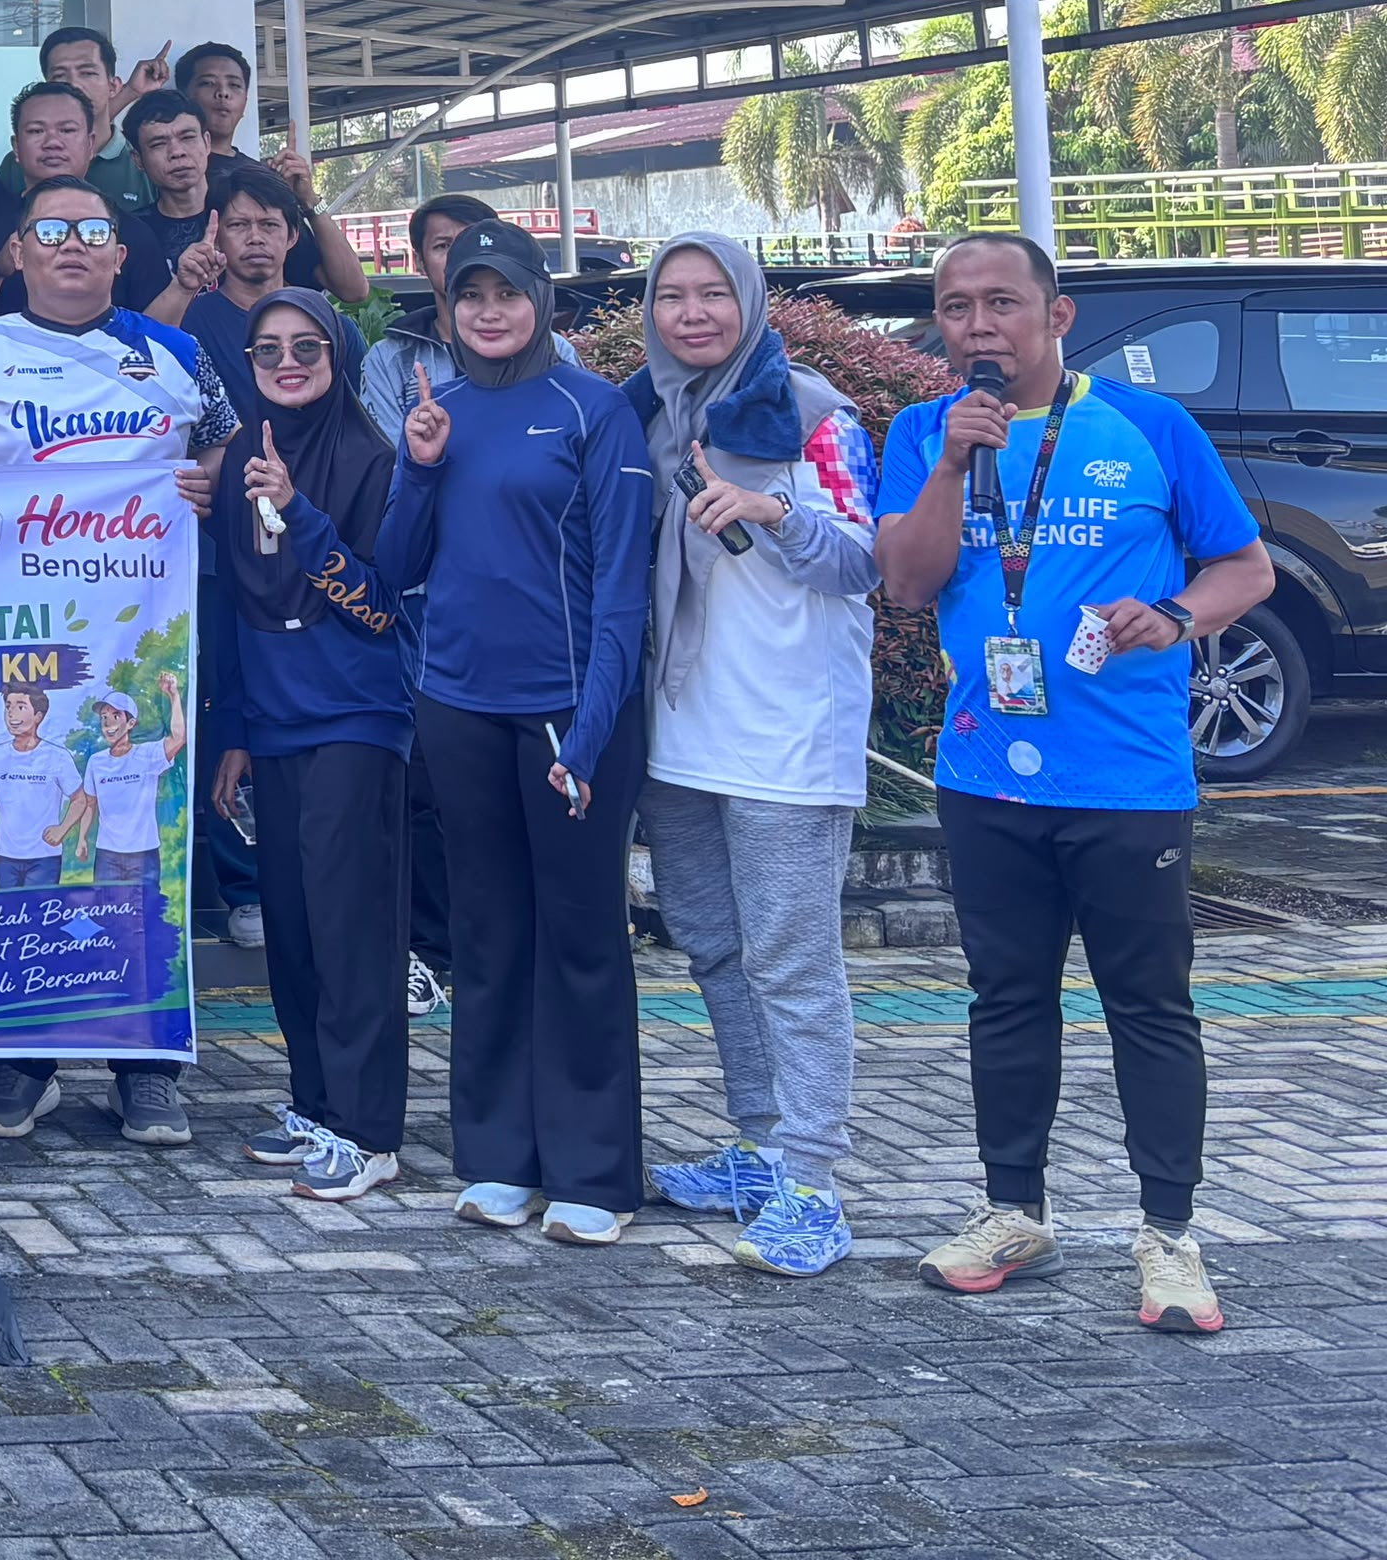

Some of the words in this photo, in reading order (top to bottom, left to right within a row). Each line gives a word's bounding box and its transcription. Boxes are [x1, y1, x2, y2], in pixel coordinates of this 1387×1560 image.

[17, 493, 172, 547] Honda
[1063, 497, 1118, 521] LIFE
[22, 552, 166, 583] Bengkulu
[1, 652, 59, 683] KM
[21, 958, 129, 995] Bersama!
